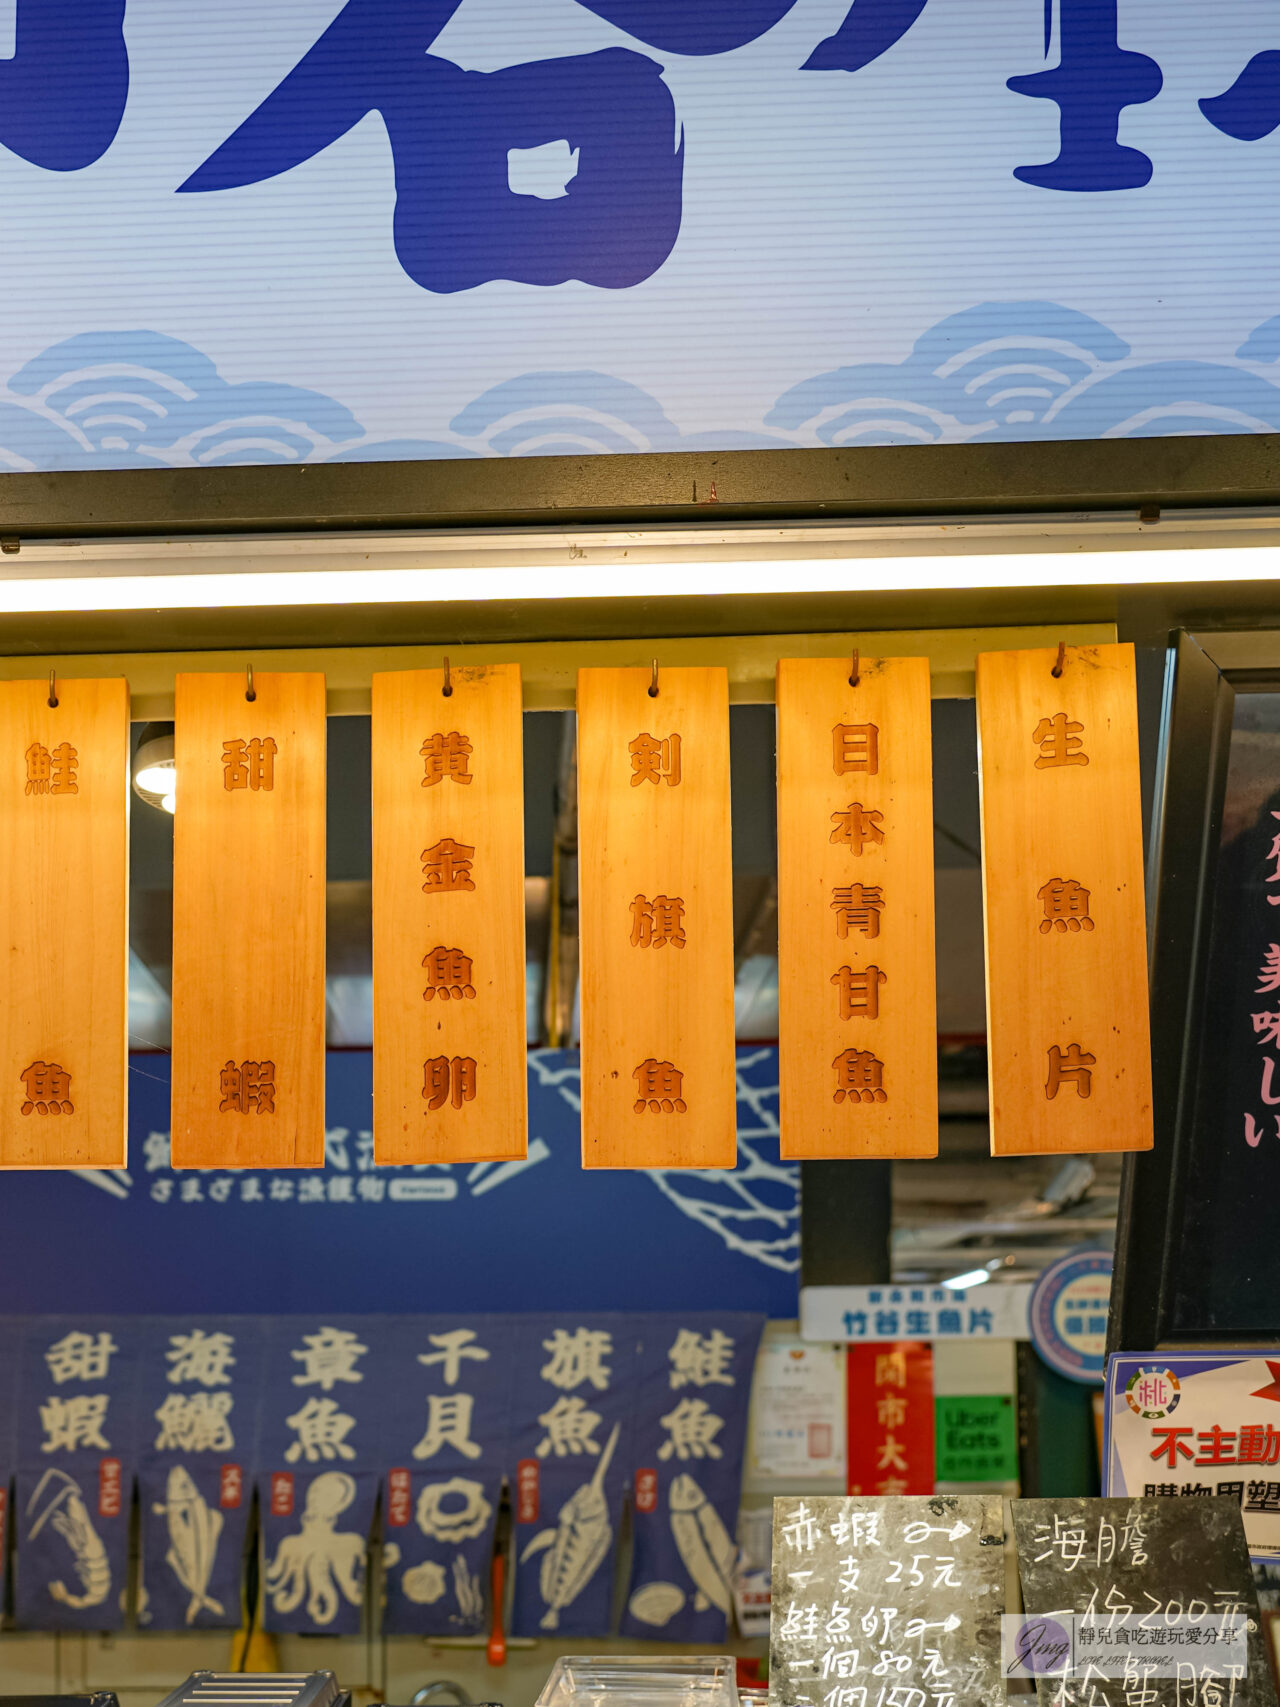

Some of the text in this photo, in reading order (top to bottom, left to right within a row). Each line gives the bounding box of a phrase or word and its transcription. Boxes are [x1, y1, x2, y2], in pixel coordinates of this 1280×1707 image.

[20, 742, 79, 1116] 鮭魚
[219, 736, 278, 1116] 甜蝦
[829, 721, 888, 1105] 日本青甘魚
[1031, 711, 1098, 1104] 生魚片
[842, 1307, 994, 1337] 竹谷生魚片
[39, 1331, 119, 1453] 甜蝦
[284, 1326, 368, 1463] 章魚
[535, 1327, 613, 1460] 旗魚
[657, 1328, 735, 1461] 鮭魚
[944, 1410, 999, 1427] Uber
[946, 1430, 1001, 1450] Eats
[1150, 1423, 1280, 1469] 不主動
[782, 1502, 881, 1552] 赤蝦
[1034, 1509, 1149, 1572] 海膽
